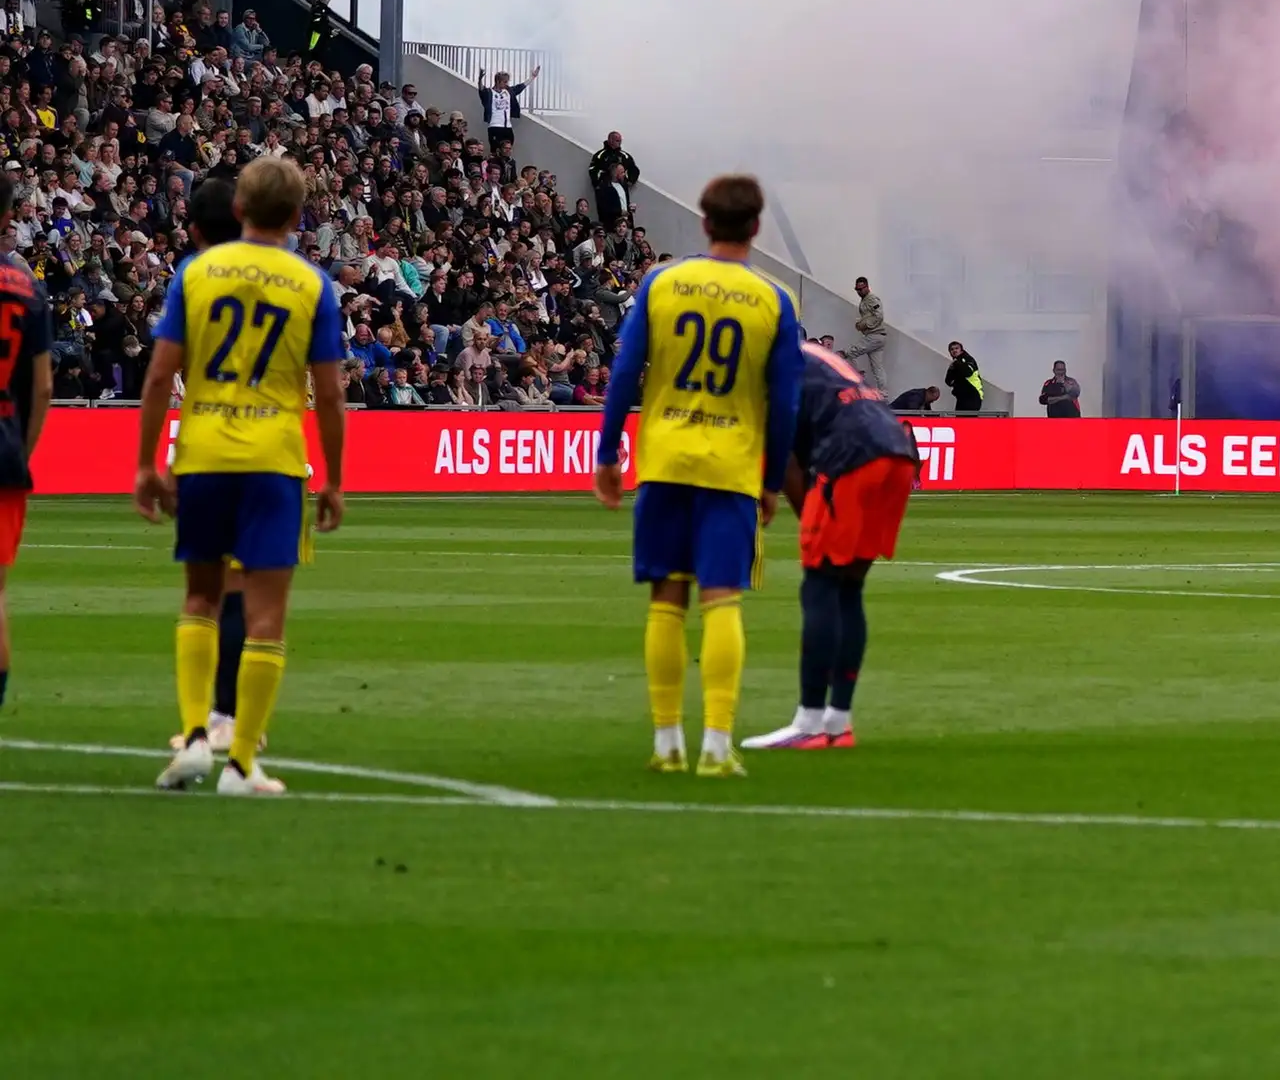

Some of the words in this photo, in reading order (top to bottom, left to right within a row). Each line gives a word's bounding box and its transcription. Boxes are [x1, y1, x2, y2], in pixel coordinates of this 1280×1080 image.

[205, 295, 291, 388] 27
[673, 310, 745, 397] 29
[435, 428, 490, 475] ALS
[499, 429, 555, 474] EEN
[1120, 433, 1208, 477] ALS
